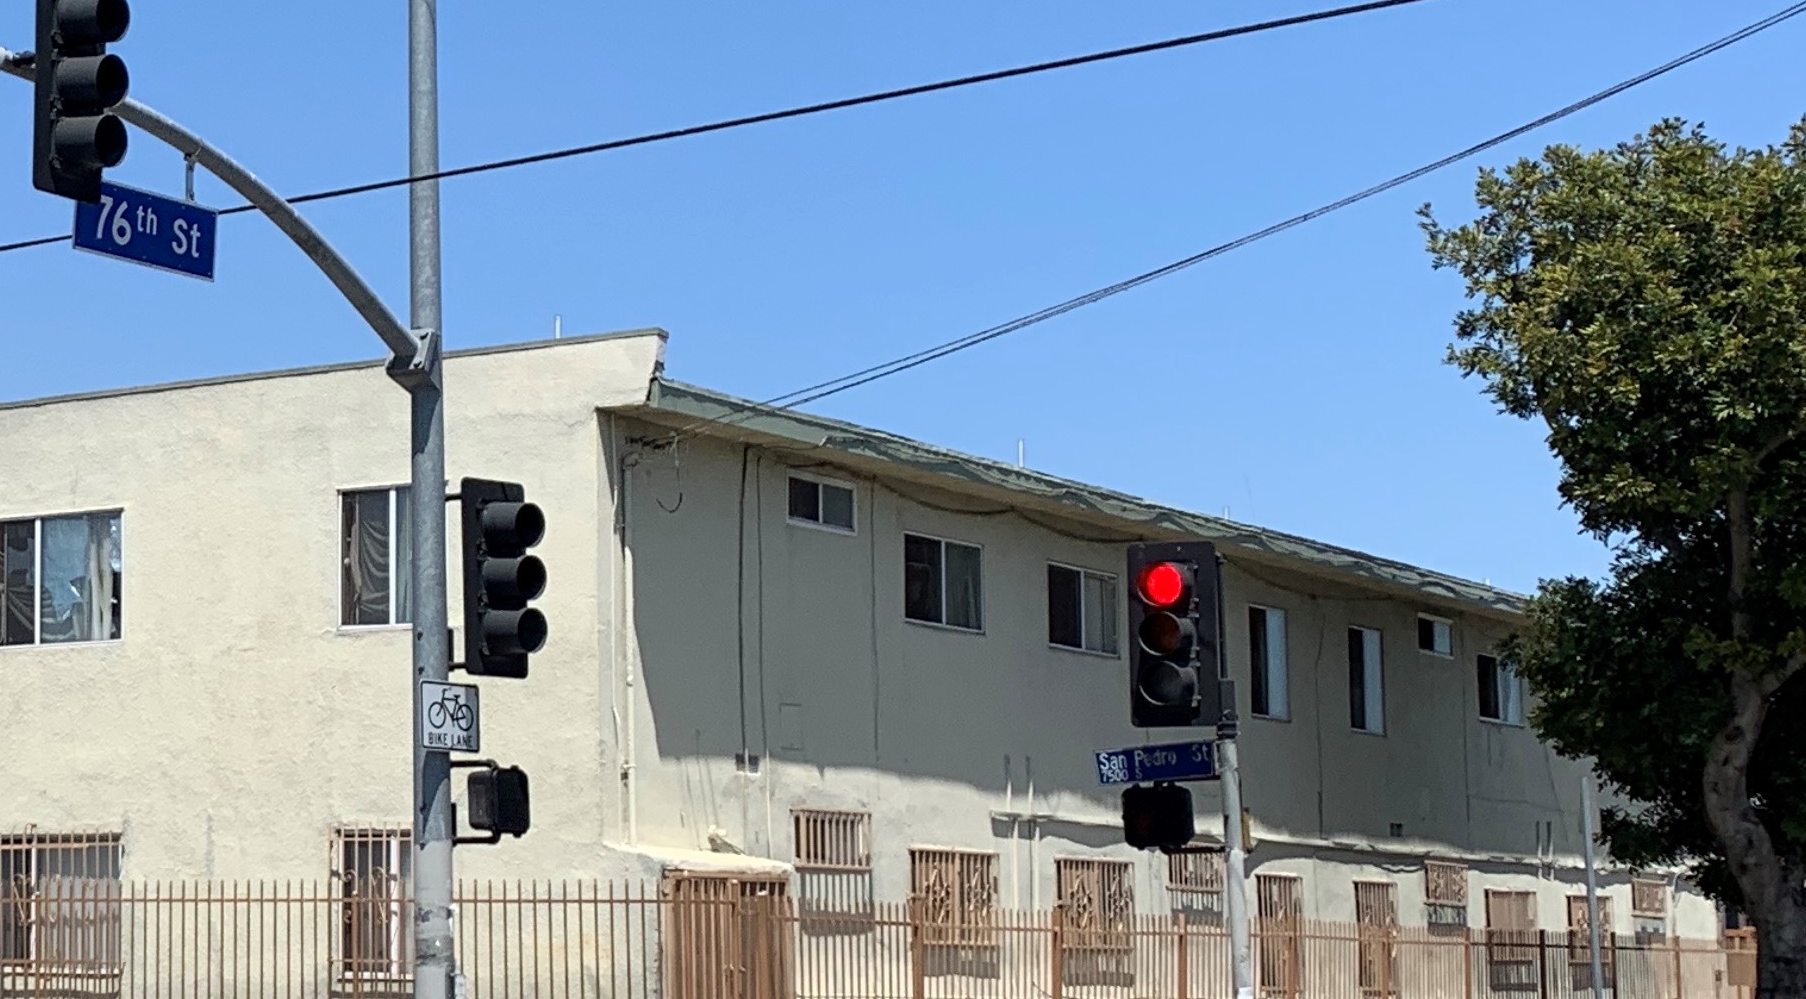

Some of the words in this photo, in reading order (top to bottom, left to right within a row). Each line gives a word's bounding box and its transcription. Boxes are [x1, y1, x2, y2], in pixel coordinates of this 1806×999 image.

[96, 194, 158, 246] 76th
[171, 218, 202, 258] St
[428, 731, 449, 746] BIKE
[451, 734, 474, 749] LANE
[1098, 752, 1128, 770] San
[1134, 749, 1177, 768] Pedro
[1191, 743, 1209, 762] St
[1101, 769, 1129, 782] 7500
[1135, 767, 1143, 779] S
